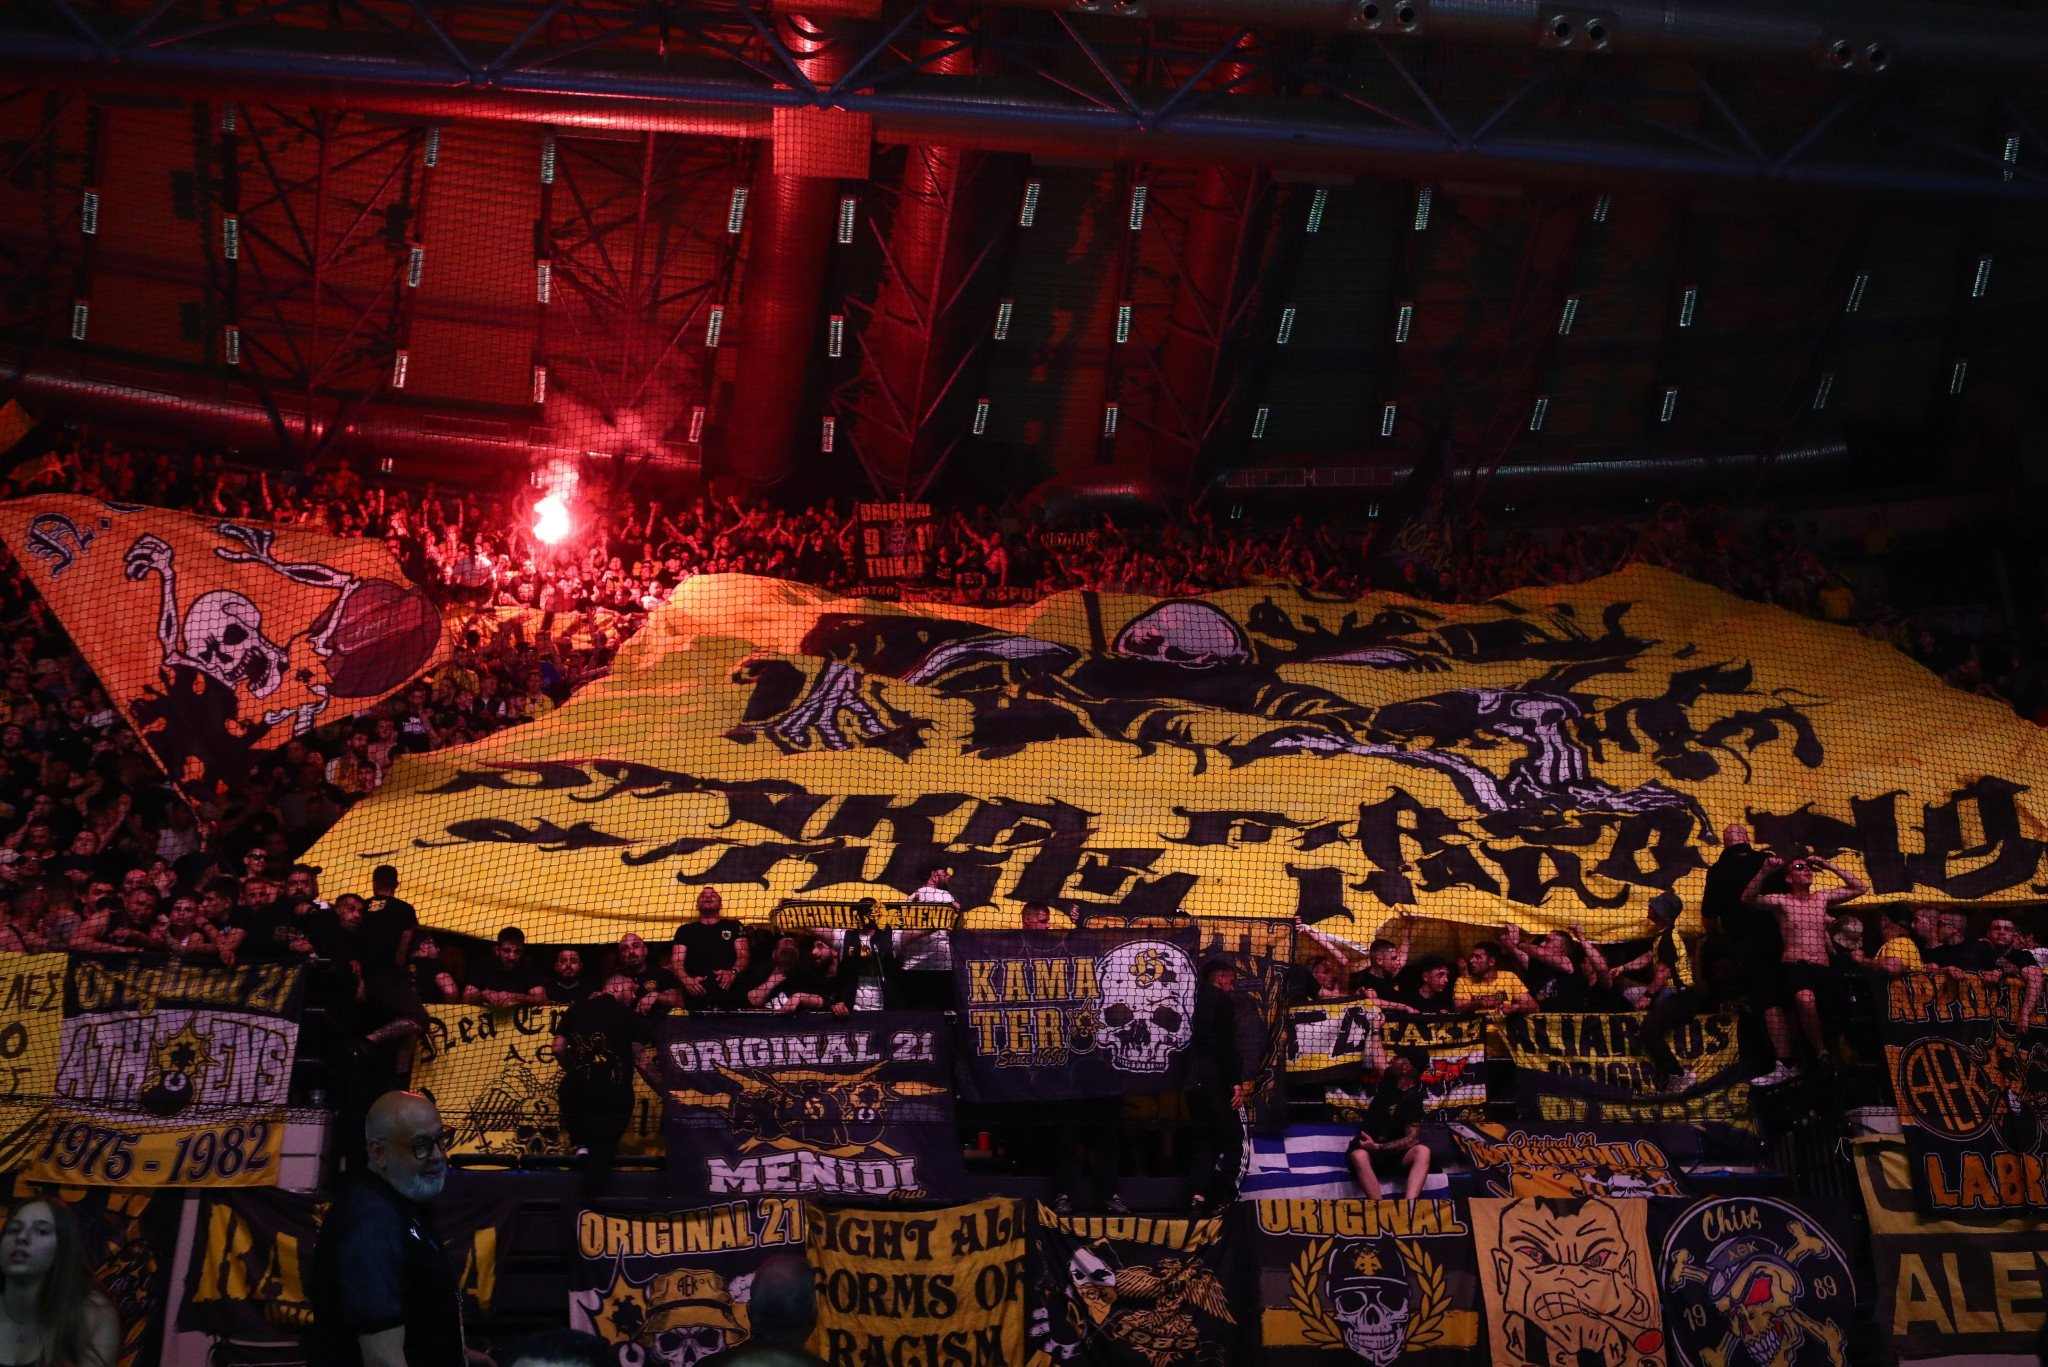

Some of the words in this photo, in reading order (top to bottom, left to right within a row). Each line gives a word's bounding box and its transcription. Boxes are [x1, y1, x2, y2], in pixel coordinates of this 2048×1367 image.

[866, 556, 925, 578] TRIKAL
[75, 959, 250, 1017] Original
[247, 963, 301, 1013] 21
[967, 957, 1101, 1004] KAMA
[668, 1032, 882, 1071] ORIGINAL
[889, 1030, 936, 1063] 21
[39, 1119, 140, 1181] 1975
[167, 1119, 272, 1184] 1982
[1510, 1132, 1576, 1153] Original
[1577, 1133, 1597, 1149] 21
[705, 1151, 920, 1195] MENIDI
[1922, 1152, 2048, 1209] LABR
[578, 1200, 757, 1259] ORIGINAL
[757, 1198, 804, 1247] 21
[1257, 1199, 1467, 1239] ORIGINAL
[1683, 1303, 1708, 1333] 19
[1812, 1274, 1839, 1300] 89
[1893, 1250, 2048, 1336] ALE
